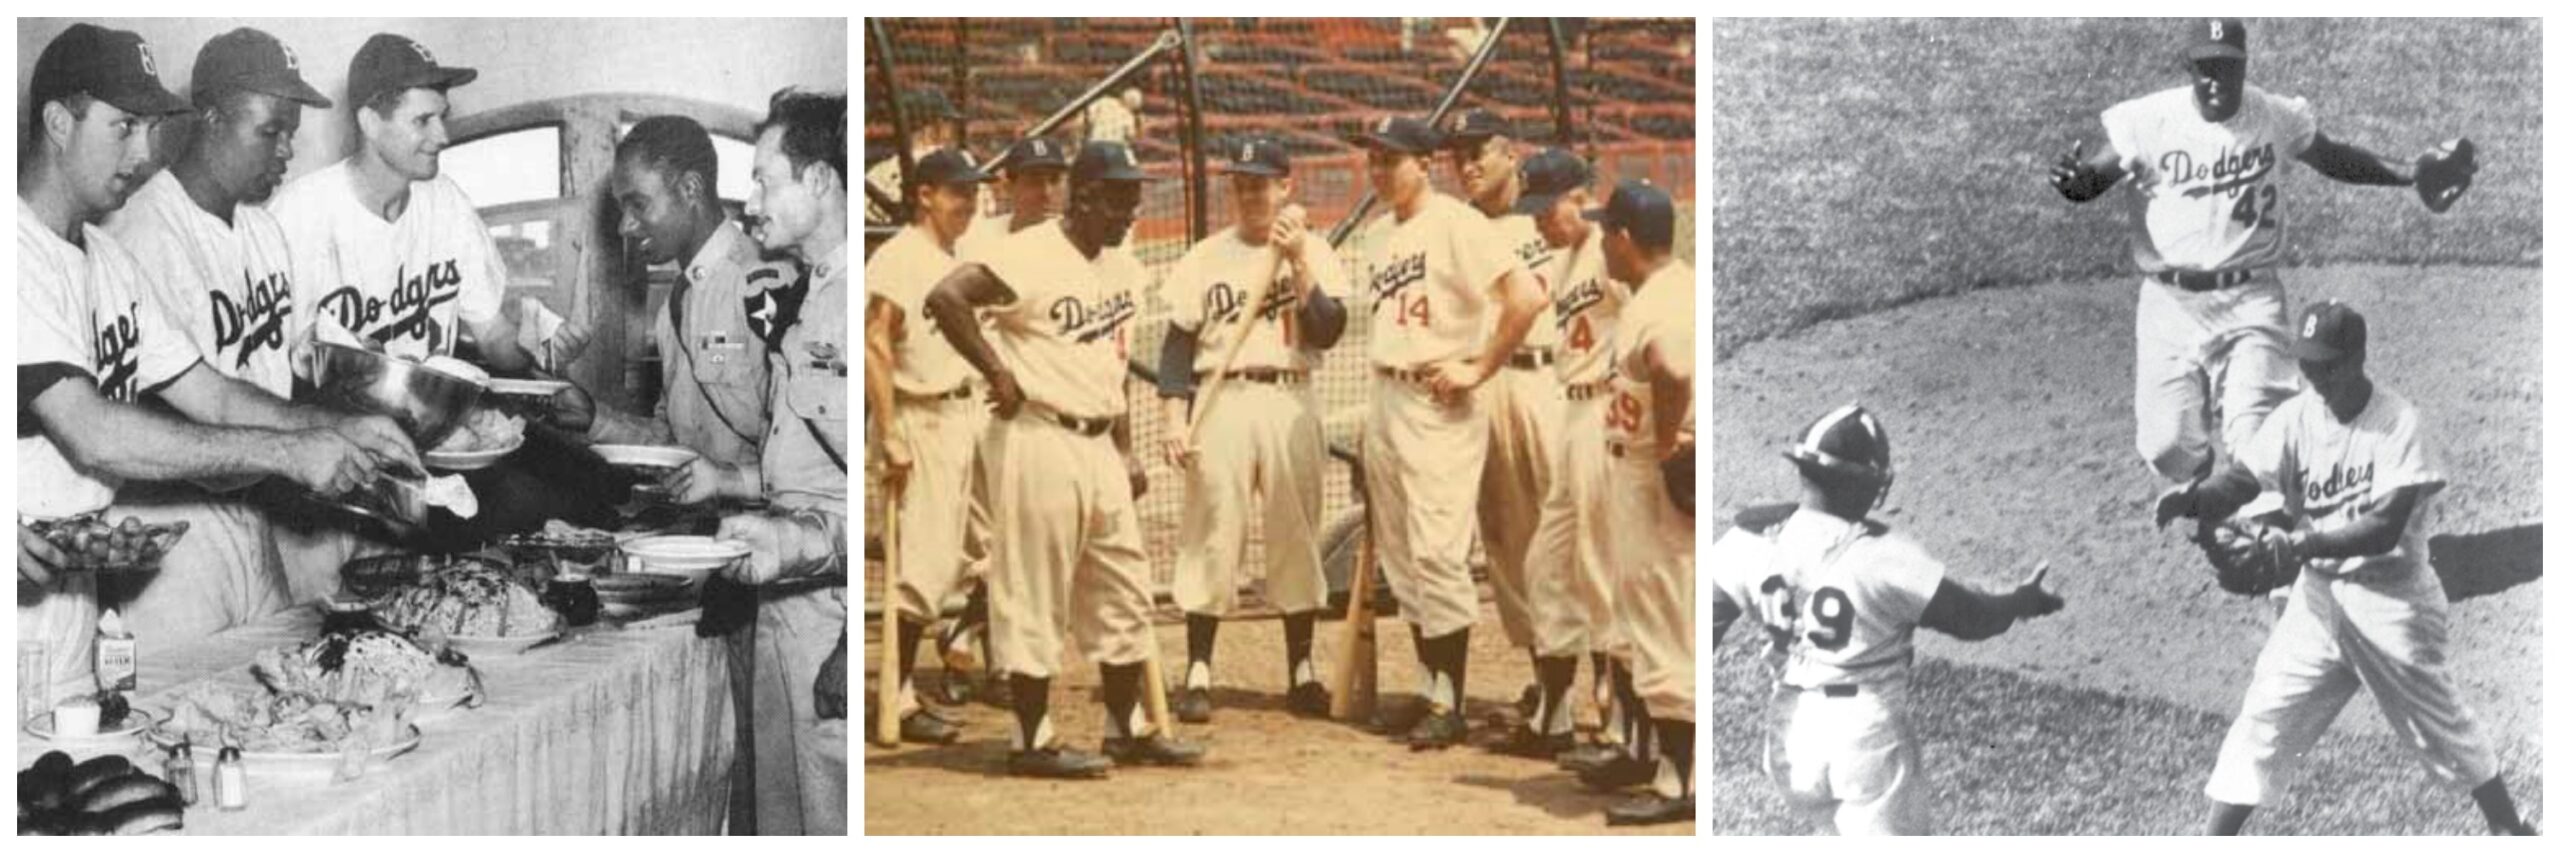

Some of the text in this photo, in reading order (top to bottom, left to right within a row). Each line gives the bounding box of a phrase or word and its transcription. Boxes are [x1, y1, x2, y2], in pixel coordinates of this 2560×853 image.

[2210, 21, 2223, 40] B
[2159, 143, 2275, 199] Dodgers
[2231, 184, 2277, 229] 42
[1396, 294, 1429, 327] 14
[2304, 314, 2317, 337] B
[1569, 315, 1595, 351] 4
